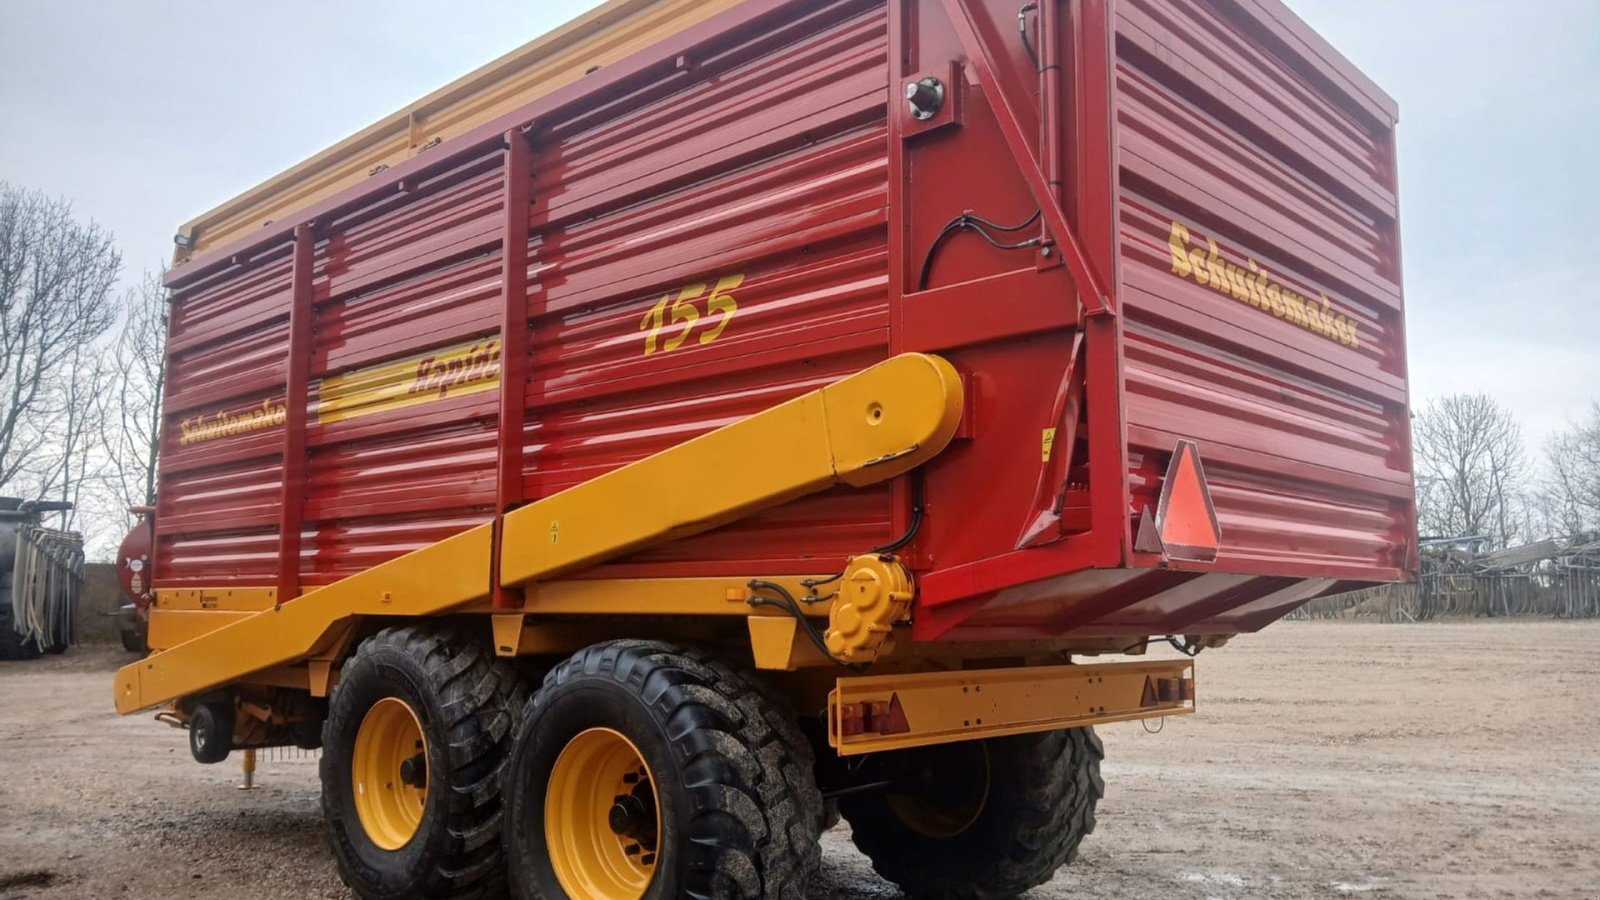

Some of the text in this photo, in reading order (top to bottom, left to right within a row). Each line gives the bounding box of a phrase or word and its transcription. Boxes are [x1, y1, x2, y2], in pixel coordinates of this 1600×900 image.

[640, 273, 745, 356] 155
[1168, 220, 1360, 349] Schuitemaker
[178, 398, 287, 445] Schuitemake
